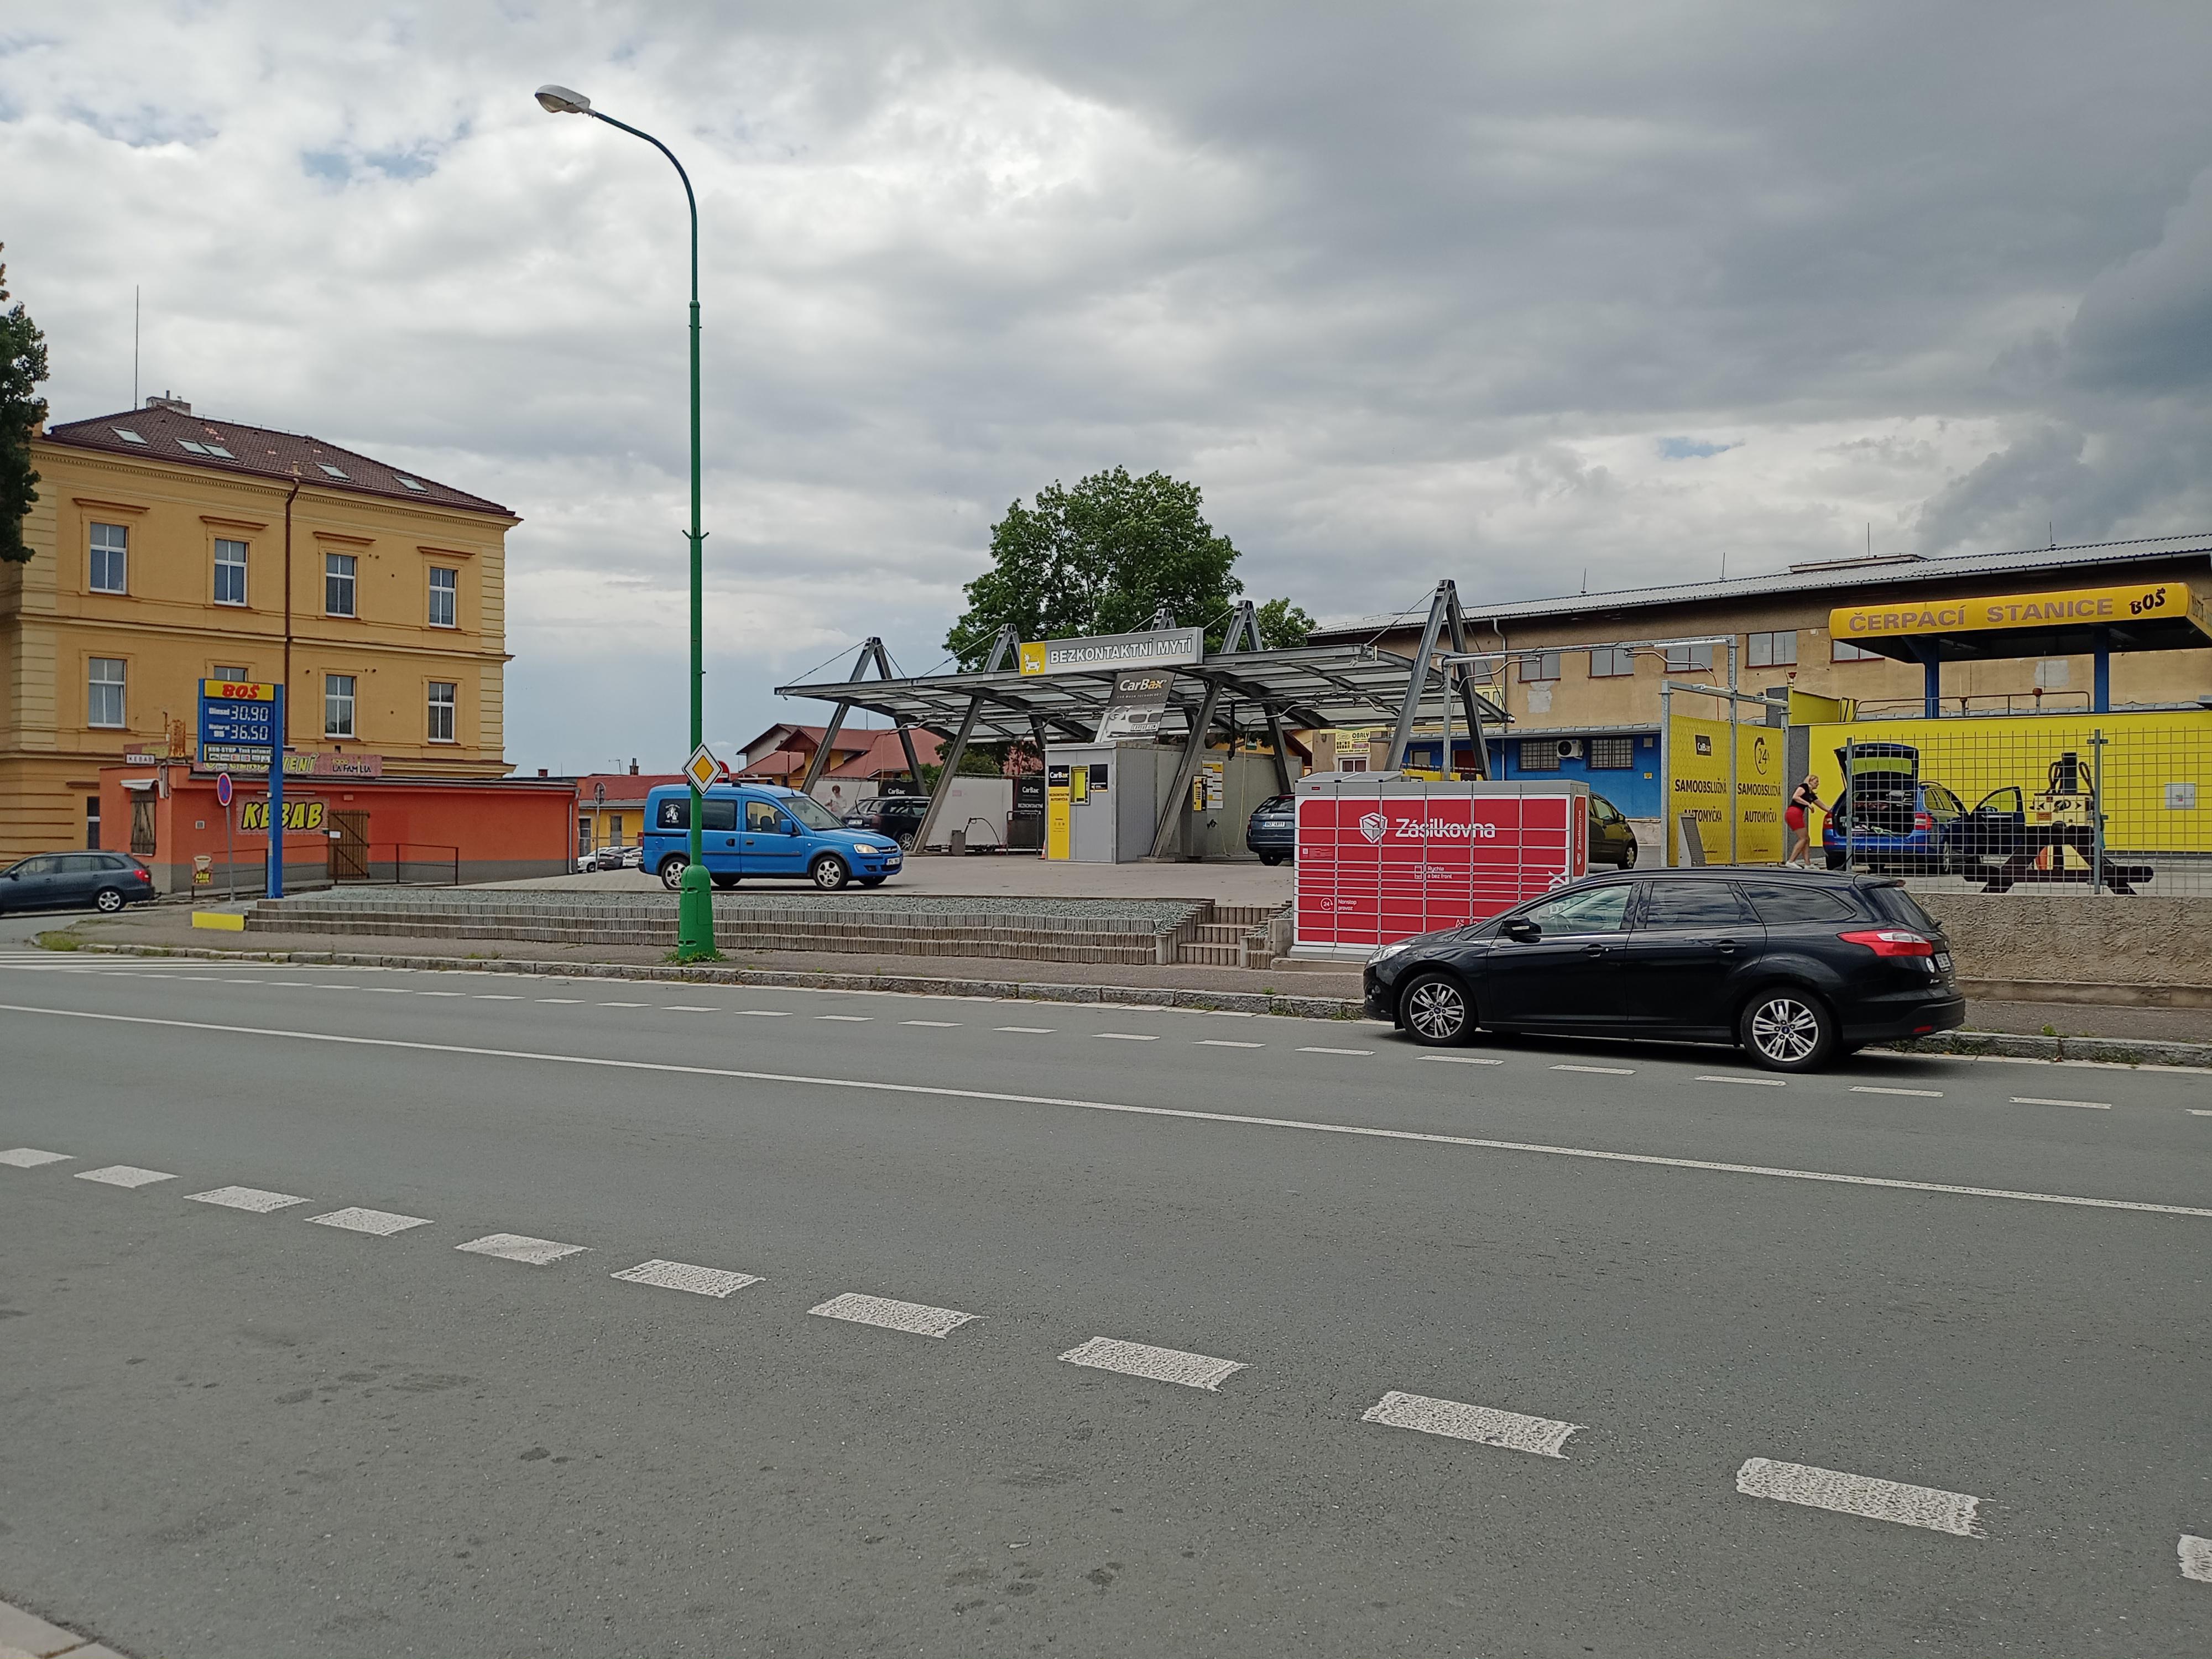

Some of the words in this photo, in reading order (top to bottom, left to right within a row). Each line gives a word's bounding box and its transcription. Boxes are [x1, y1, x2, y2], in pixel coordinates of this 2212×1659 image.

[1849, 605, 1966, 632] ČERPACÍ
[1986, 598, 2114, 623] STANICE
[2128, 587, 2166, 615] BOŠ
[1050, 638, 1154, 664] BEZKONTAKTNÍ
[1157, 635, 1193, 655] MYTÍ
[222, 684, 260, 699] BOŠ
[1119, 679, 1164, 692] CarBax
[231, 705, 269, 722] 30.90
[230, 724, 268, 740] 36.50
[1675, 778, 1727, 794] SAMOOBSLUŽNÁ
[1738, 781, 1781, 796] SAMOOBSLUŽNÁ
[241, 802, 324, 830] KEBAB
[1684, 806, 1722, 822] TOMYČKA
[1744, 808, 1777, 823] AUTOMYČKA
[1395, 818, 1495, 838] Zásilkovna
